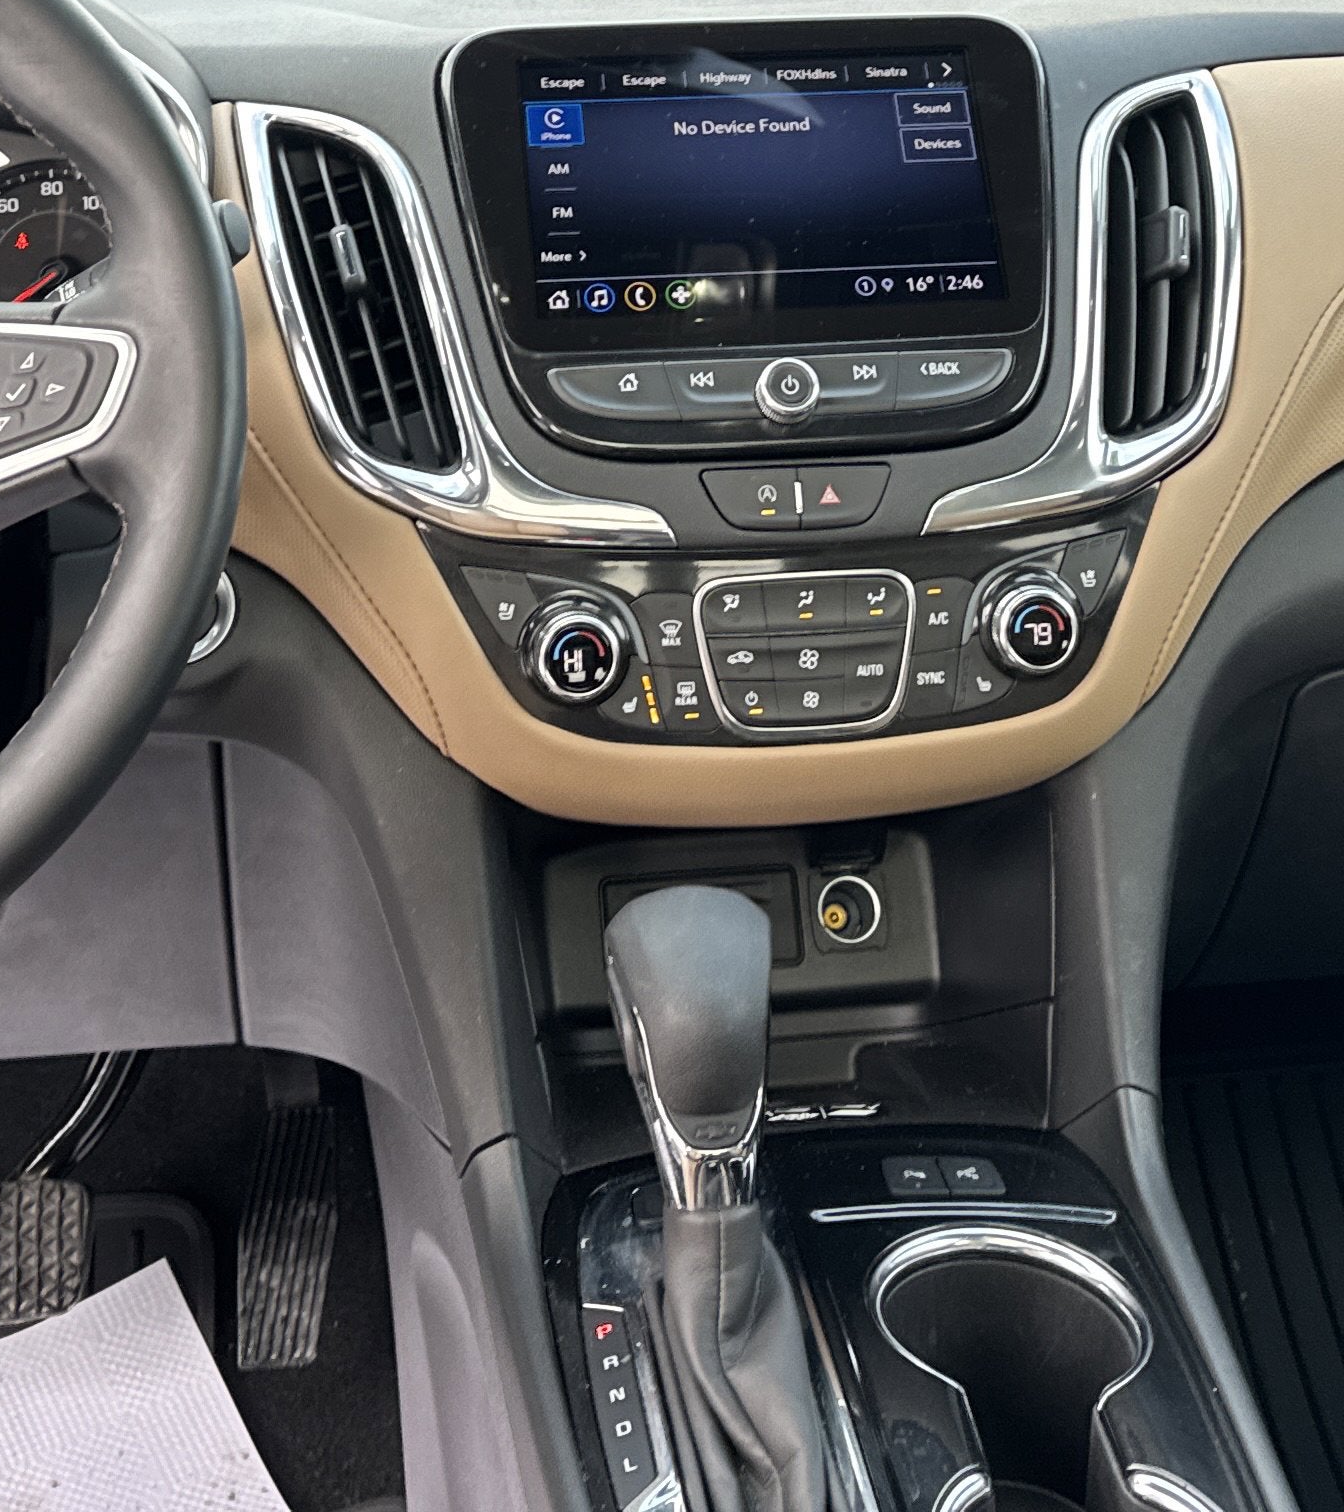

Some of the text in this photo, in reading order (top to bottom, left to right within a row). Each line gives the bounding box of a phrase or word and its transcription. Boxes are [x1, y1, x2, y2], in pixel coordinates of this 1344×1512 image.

[540, 76, 585, 90] Escape
[622, 74, 667, 88] Escape
[699, 71, 752, 87] Highway
[865, 65, 908, 79] Sinatra
[912, 101, 952, 115] Sound
[673, 116, 811, 136] No Device Found
[540, 131, 572, 142] iPhone
[913, 137, 963, 150] Devices
[547, 163, 570, 175] AM
[40, 180, 64, 196] 80
[82, 195, 100, 211] 10
[552, 206, 574, 219] FM
[540, 251, 573, 263] More
[906, 275, 935, 292] 16°
[946, 274, 984, 291] 2:46
[928, 361, 961, 376] BACK
[928, 611, 950, 627] A/C
[661, 637, 682, 647] MAX
[1024, 622, 1052, 646] 79
[563, 648, 583, 673] HI
[856, 663, 885, 677] AUTO
[916, 671, 946, 686] SYNC
[674, 695, 699, 706] REAR
[595, 1322, 613, 1340] P
[602, 1354, 620, 1370] R
[608, 1386, 626, 1404] N
[615, 1420, 633, 1437] D
[623, 1457, 639, 1473] L
